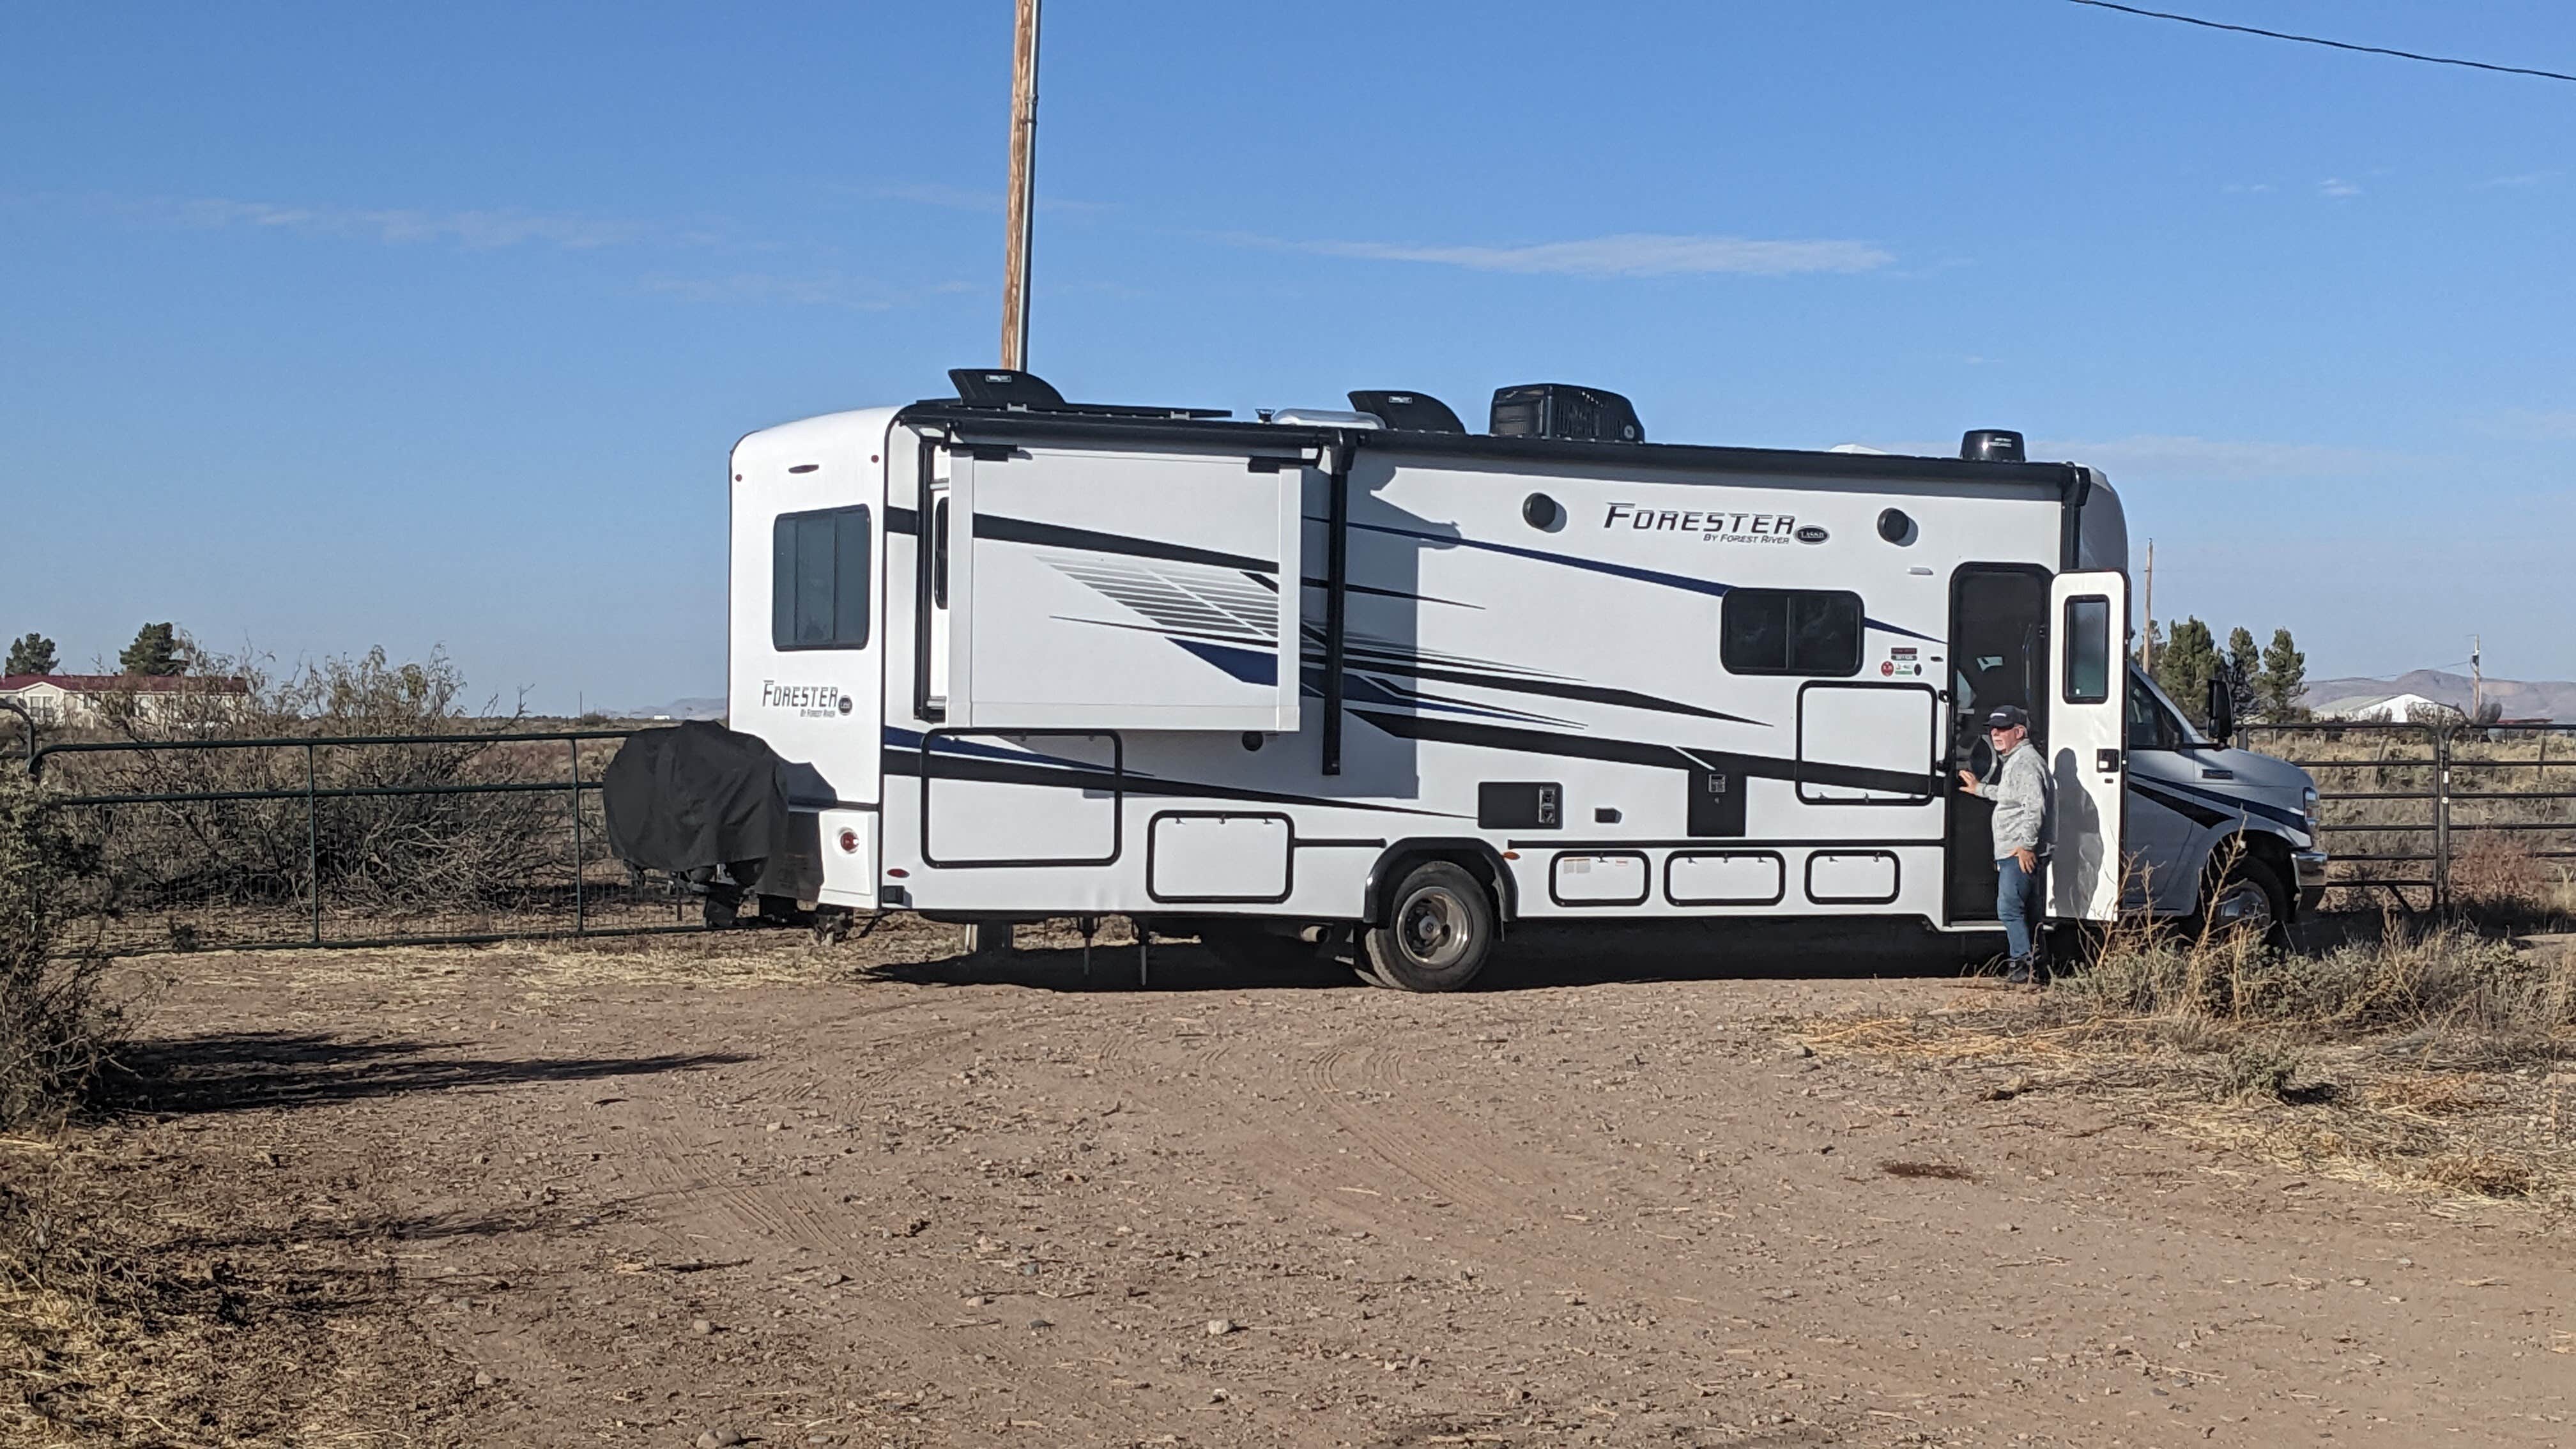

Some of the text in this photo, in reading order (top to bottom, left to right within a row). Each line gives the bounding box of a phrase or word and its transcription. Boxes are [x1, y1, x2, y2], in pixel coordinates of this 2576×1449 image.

[1604, 502, 1796, 535] FORESTER
[1703, 533, 1790, 544] BY FOREST RIVER
[762, 680, 839, 707] FORESTER
